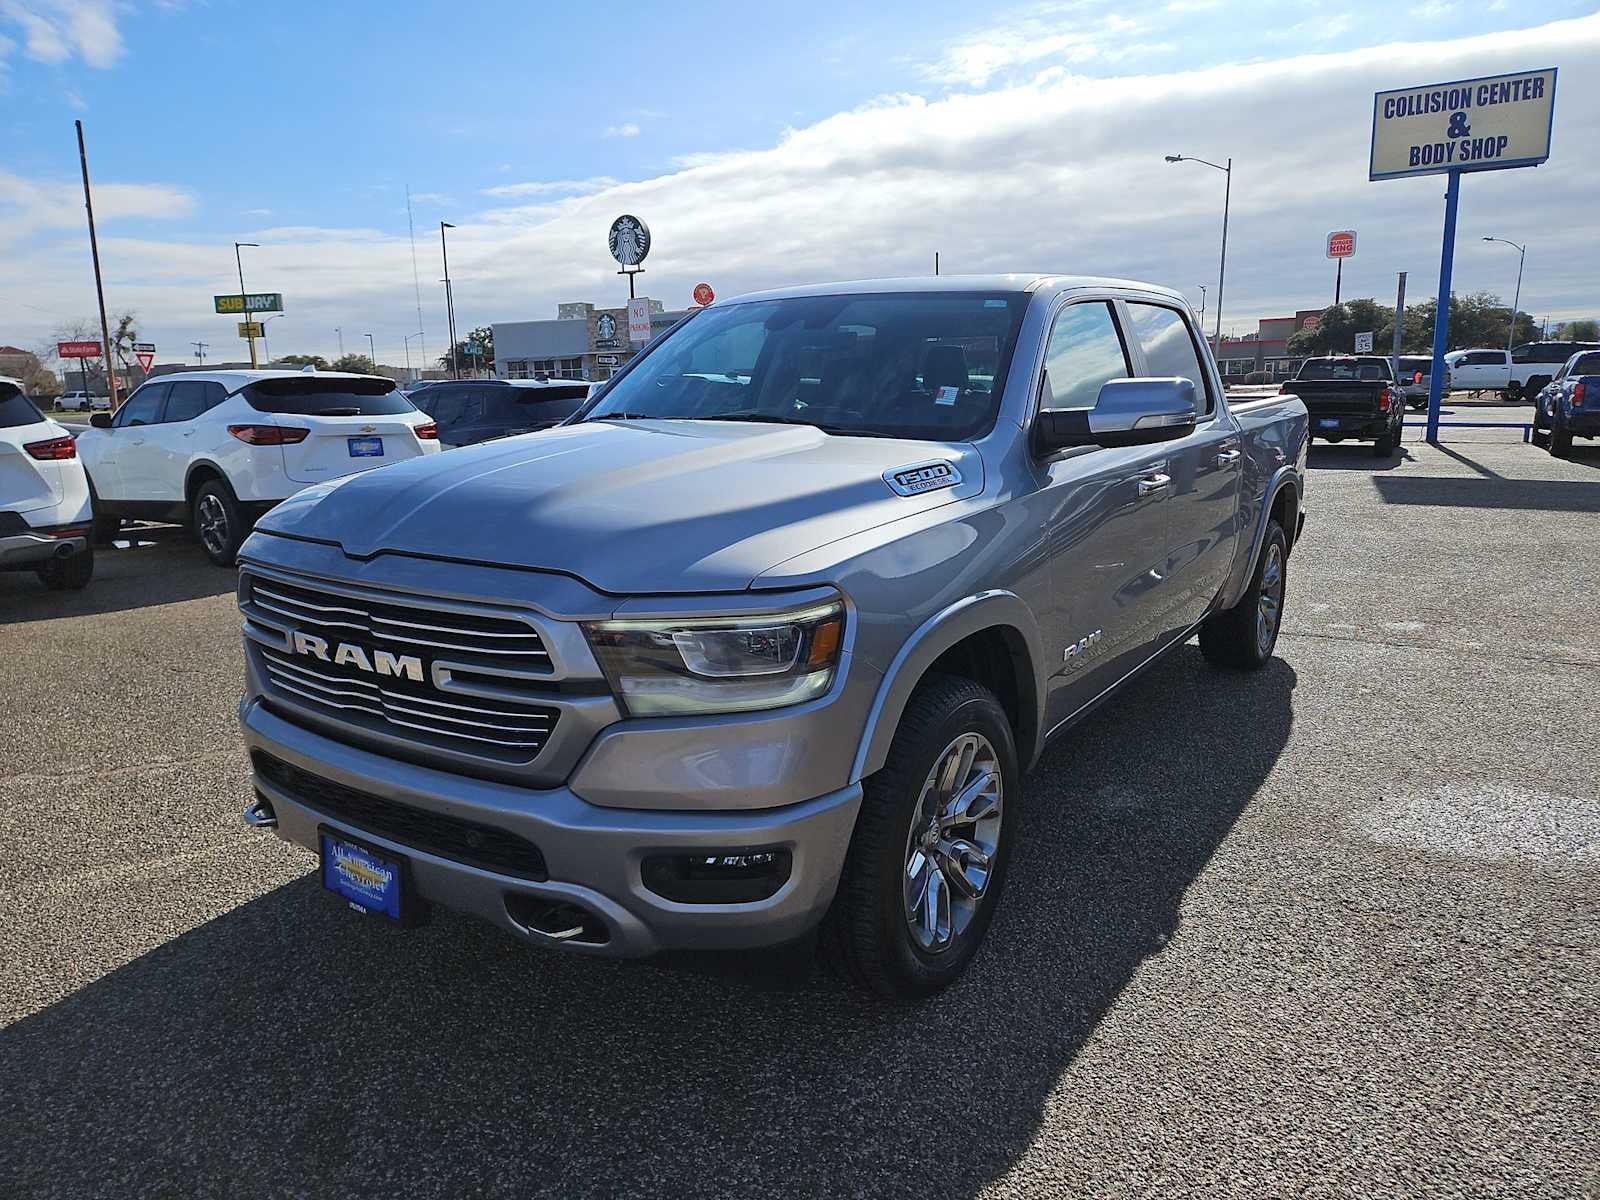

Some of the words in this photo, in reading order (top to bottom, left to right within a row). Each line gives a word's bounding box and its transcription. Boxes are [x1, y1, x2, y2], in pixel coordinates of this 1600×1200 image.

[1384, 86, 1473, 119] COLLISION
[1476, 76, 1545, 107] CENTER
[1447, 111, 1471, 139] &
[1409, 141, 1456, 167] BODY
[1459, 135, 1508, 161] SHOP
[1330, 244, 1353, 252] KING
[218, 296, 272, 310] SUBWAY
[633, 307, 644, 318] NO
[1357, 342, 1371, 351] 35
[896, 465, 948, 485] 1500
[1063, 629, 1102, 661] RAM
[294, 631, 424, 682] RAM
[331, 845, 344, 857] All
